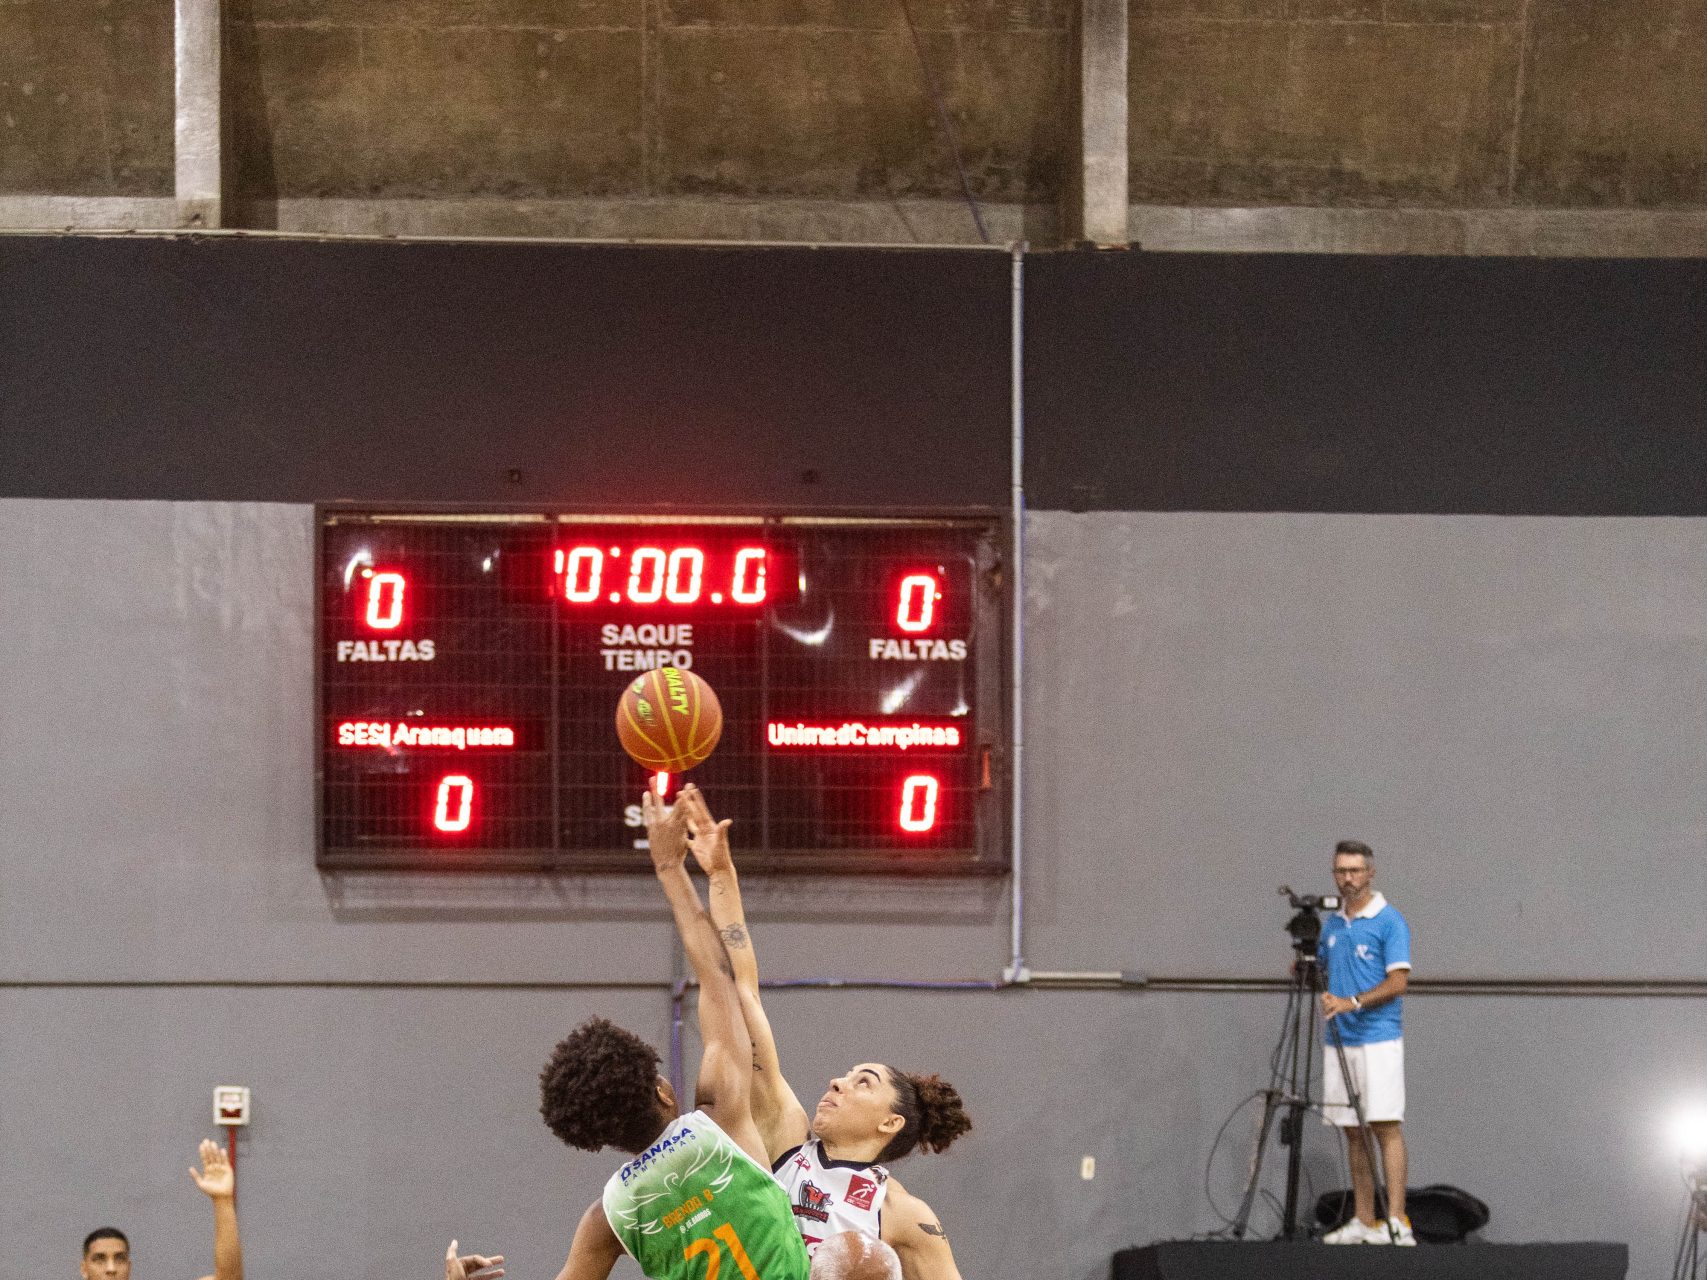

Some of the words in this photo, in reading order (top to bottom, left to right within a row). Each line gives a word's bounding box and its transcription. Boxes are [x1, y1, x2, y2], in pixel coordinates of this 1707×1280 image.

[366, 573, 406, 629] 0
[896, 575, 936, 632] 0
[336, 639, 436, 662] FALTAS
[600, 650, 693, 671] TEMPO
[601, 624, 693, 646] SAQUE
[868, 638, 968, 661] FALTAS
[434, 775, 474, 832] 0
[900, 775, 938, 832] 0
[624, 1133, 697, 1187] CAMPINAS
